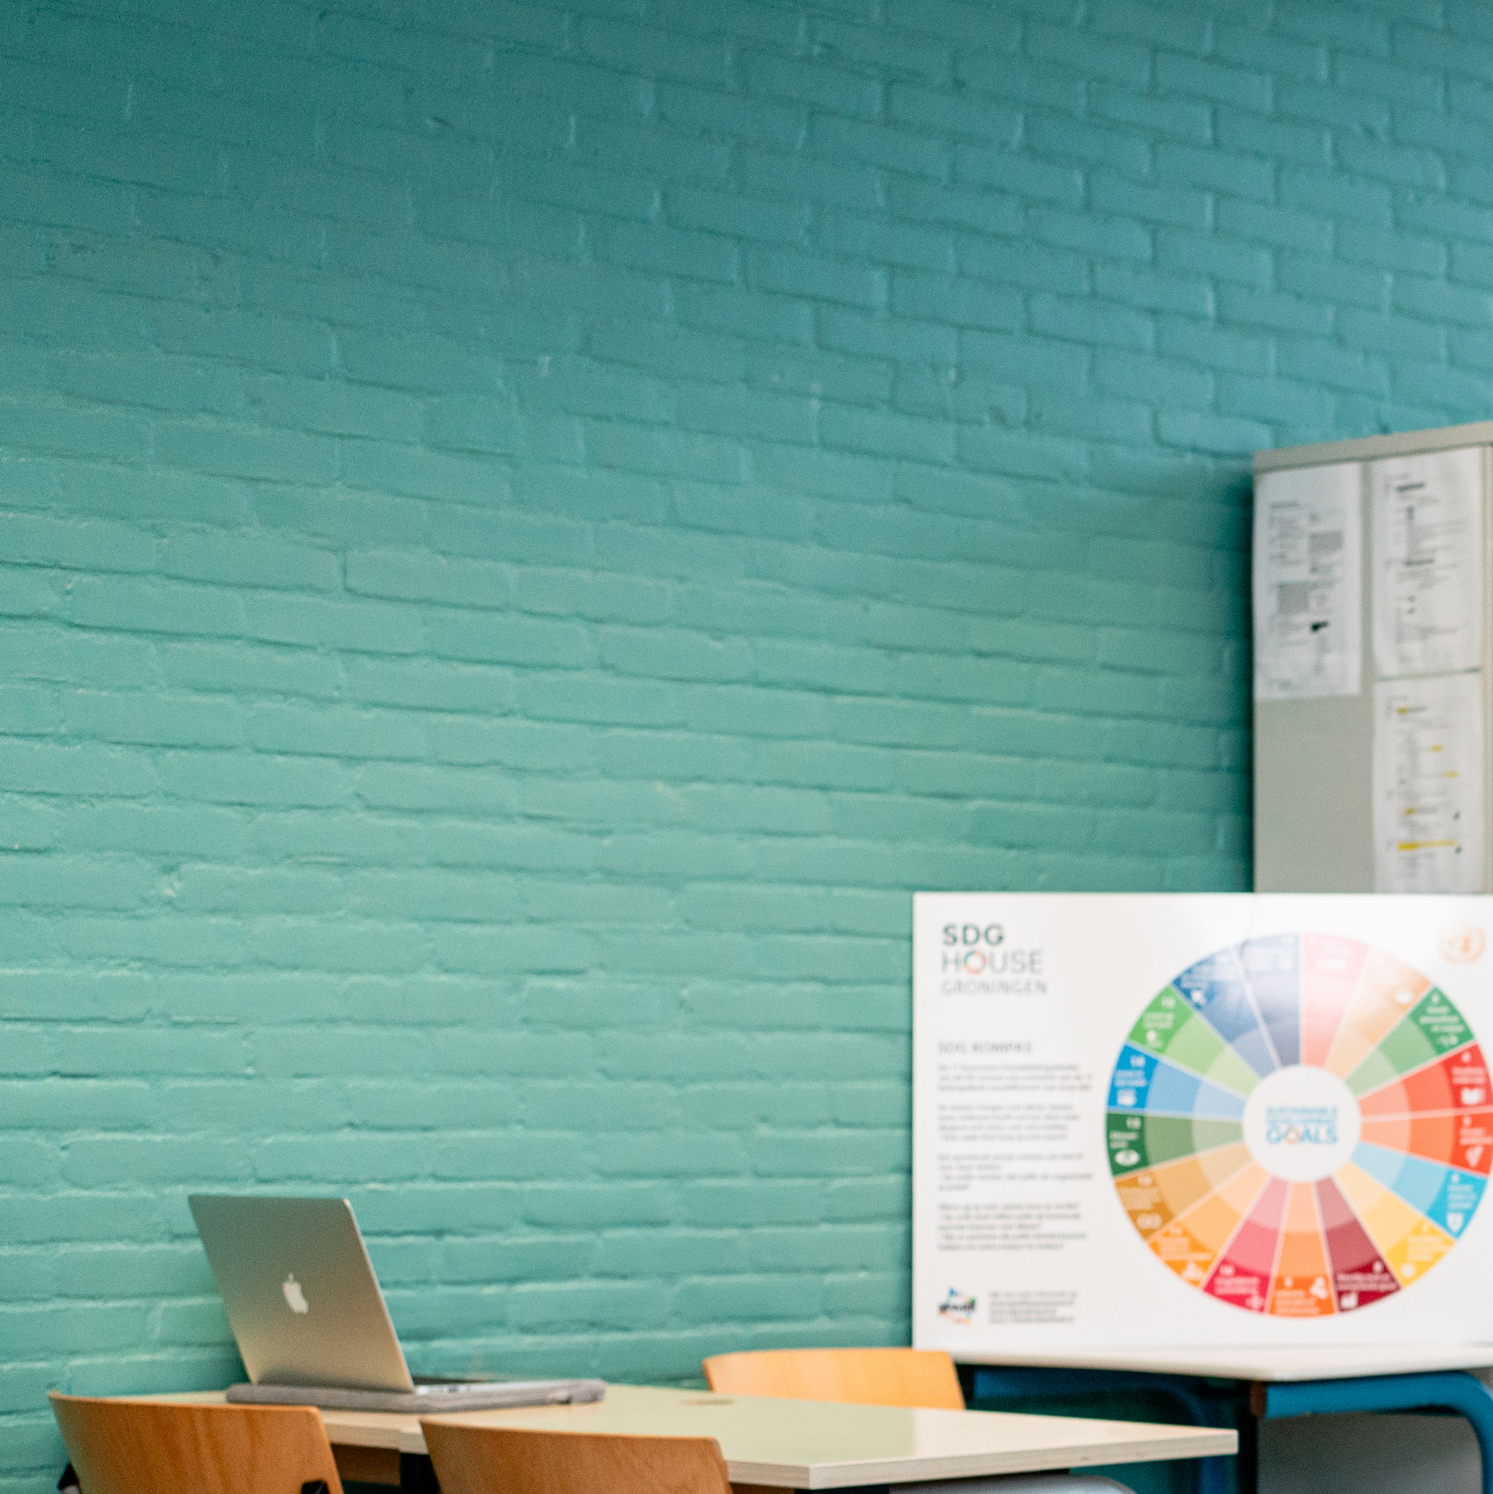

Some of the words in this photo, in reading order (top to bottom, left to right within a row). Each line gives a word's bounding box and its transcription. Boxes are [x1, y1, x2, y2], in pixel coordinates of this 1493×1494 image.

[942, 923, 1005, 946] SDG
[940, 949, 1044, 975] HOUSE
[940, 979, 1049, 996] GRONINGEN
[1265, 1125, 1338, 1145] GOALS
